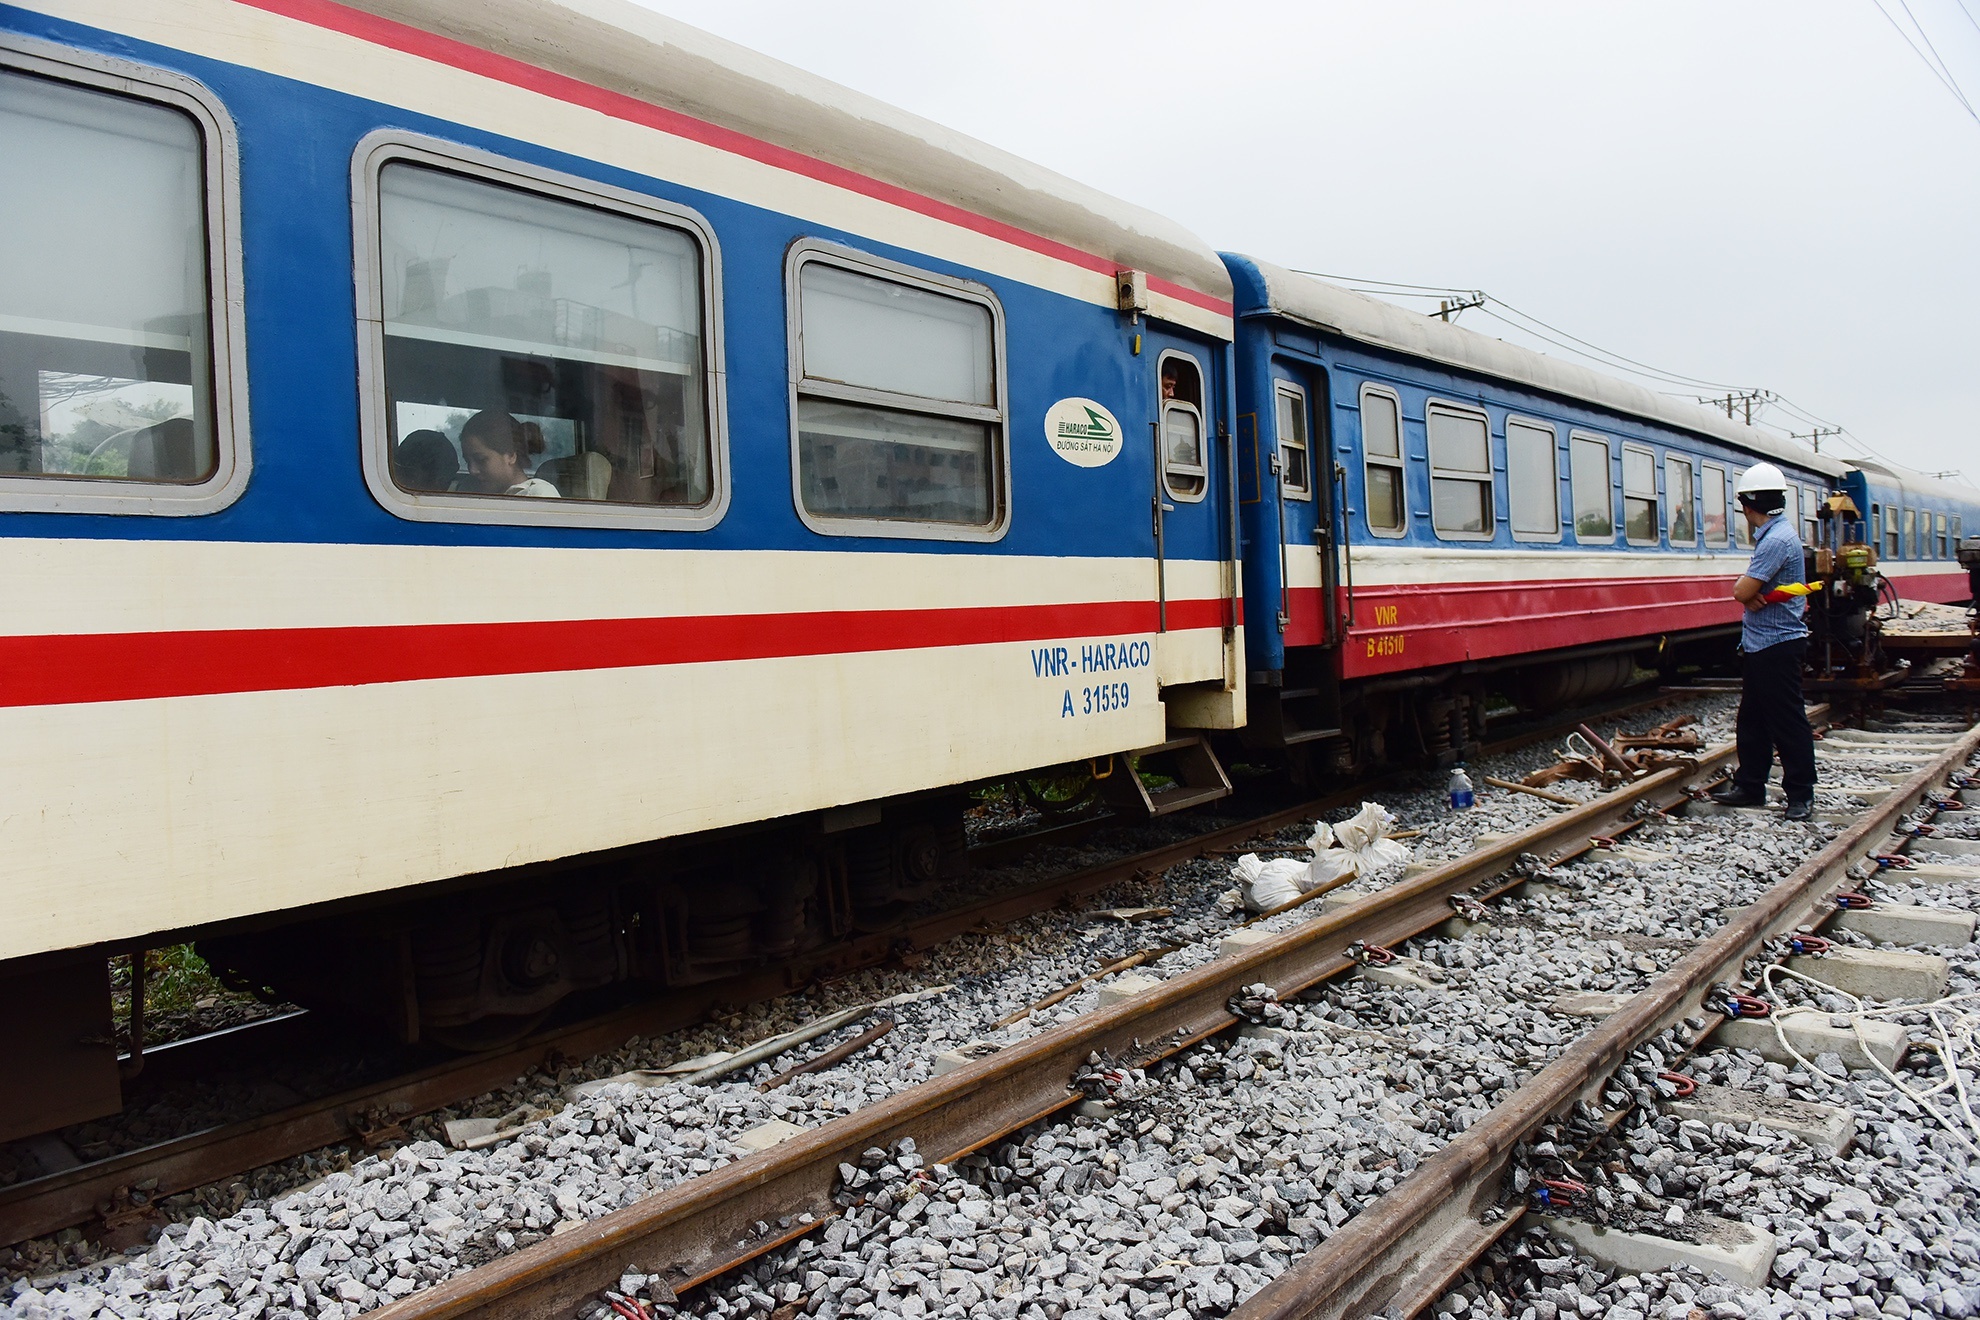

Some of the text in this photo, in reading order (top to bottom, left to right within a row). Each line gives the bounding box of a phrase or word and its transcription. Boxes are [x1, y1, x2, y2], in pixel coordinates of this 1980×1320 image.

[1065, 423, 1088, 435] HARACO
[1375, 606, 1397, 625] VNR
[1367, 634, 1405, 658] B 41510
[1061, 681, 1129, 718] A 31559
